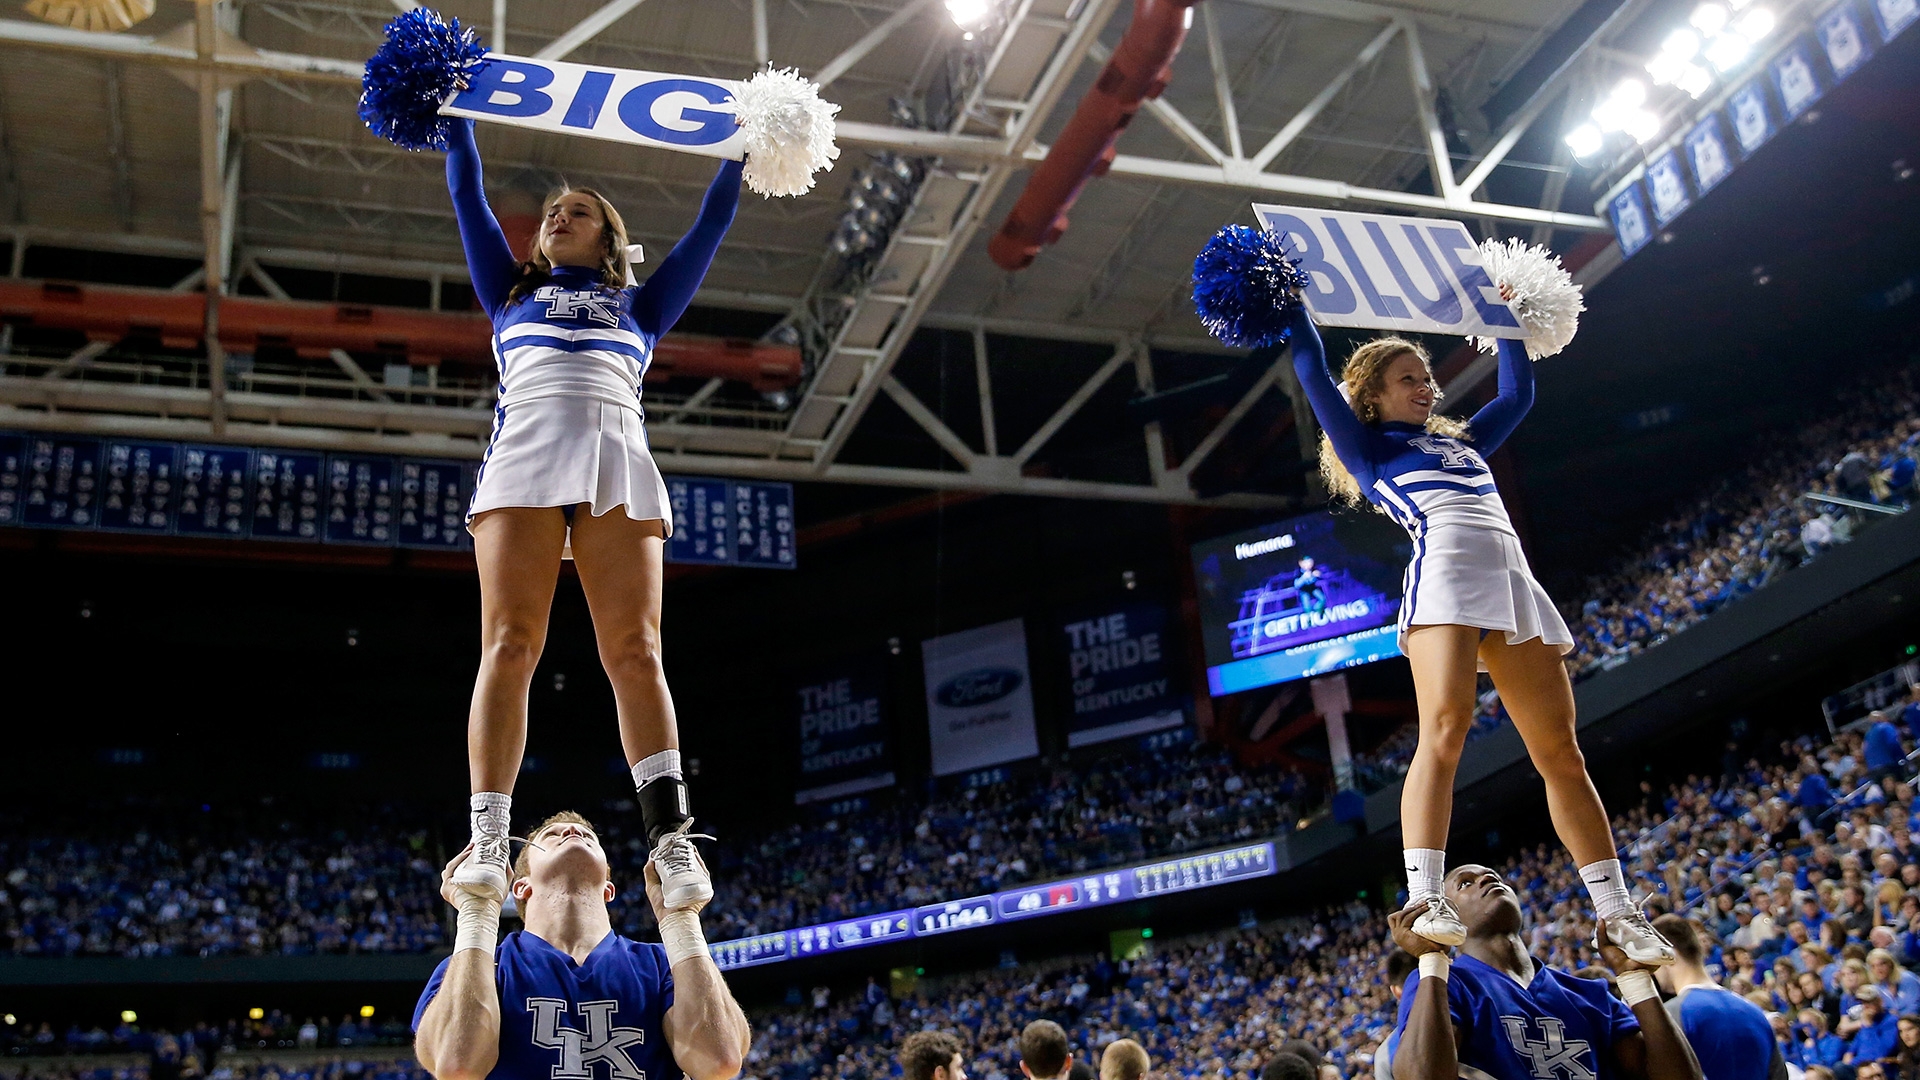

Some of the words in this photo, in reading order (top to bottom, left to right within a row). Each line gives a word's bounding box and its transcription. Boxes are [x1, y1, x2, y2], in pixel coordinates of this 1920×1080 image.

[450, 58, 741, 146] BIG
[1263, 211, 1520, 328] BLUE
[1064, 613, 1127, 649] THE
[1264, 614, 1300, 638] GET
[1300, 599, 1370, 631] MOVING
[1070, 633, 1161, 678] PRIDE
[799, 678, 850, 711] THE
[1073, 677, 1095, 695] OF
[1074, 678, 1168, 714] KENTUCKY
[801, 698, 879, 738] PRIDE
[802, 739, 821, 756] OF
[803, 742, 884, 773] KENTUCKY
[923, 906, 988, 932] 11:44
[1018, 893, 1042, 910] 49
[526, 997, 646, 1080] UK
[1500, 1016, 1597, 1080] UK
